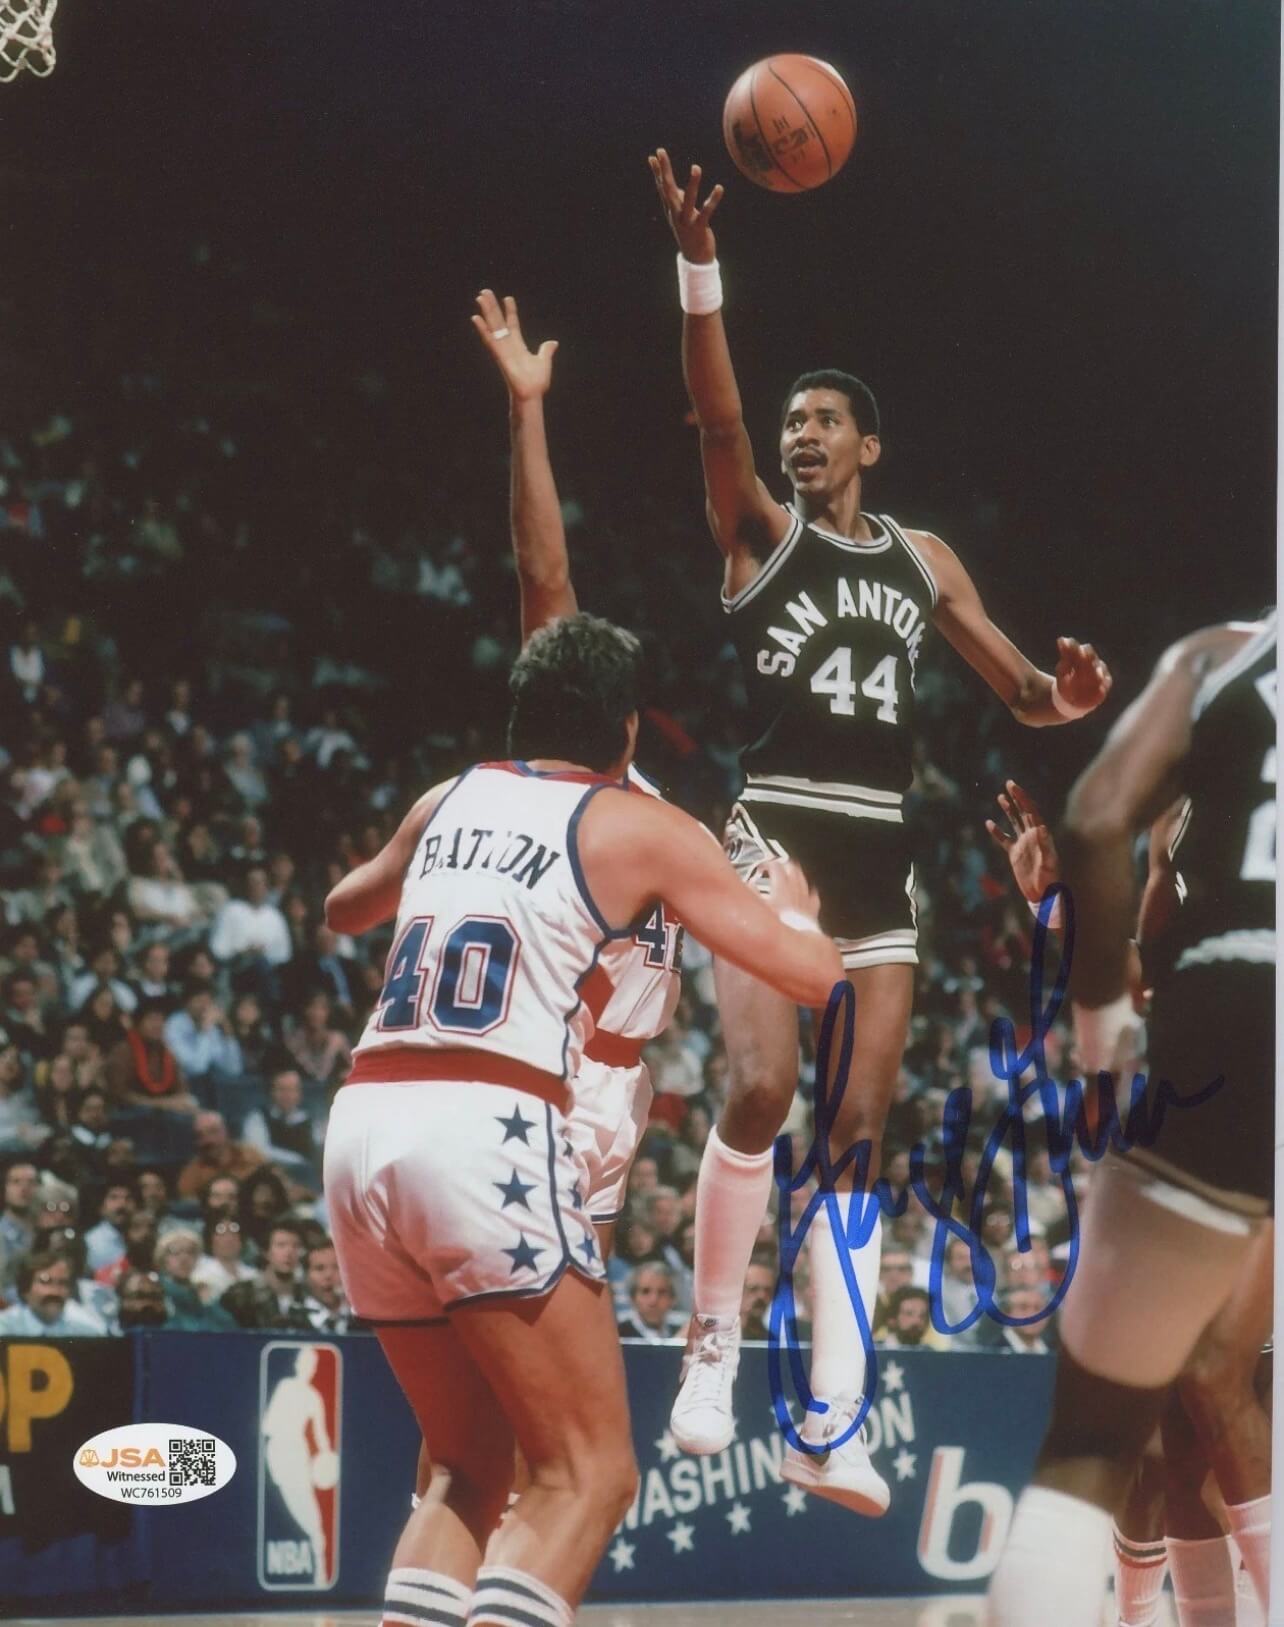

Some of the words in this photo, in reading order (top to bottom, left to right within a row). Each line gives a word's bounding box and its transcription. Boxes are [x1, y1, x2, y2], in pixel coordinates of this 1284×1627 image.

[757, 590, 828, 677] SAN
[810, 647, 898, 724] 44
[376, 914, 521, 1036] 40
[0, 1344, 74, 1452] P
[102, 1448, 166, 1468] JSA
[107, 1471, 166, 1482] Witnessed
[121, 1487, 182, 1498] WC761509
[267, 1540, 313, 1575] NBA
